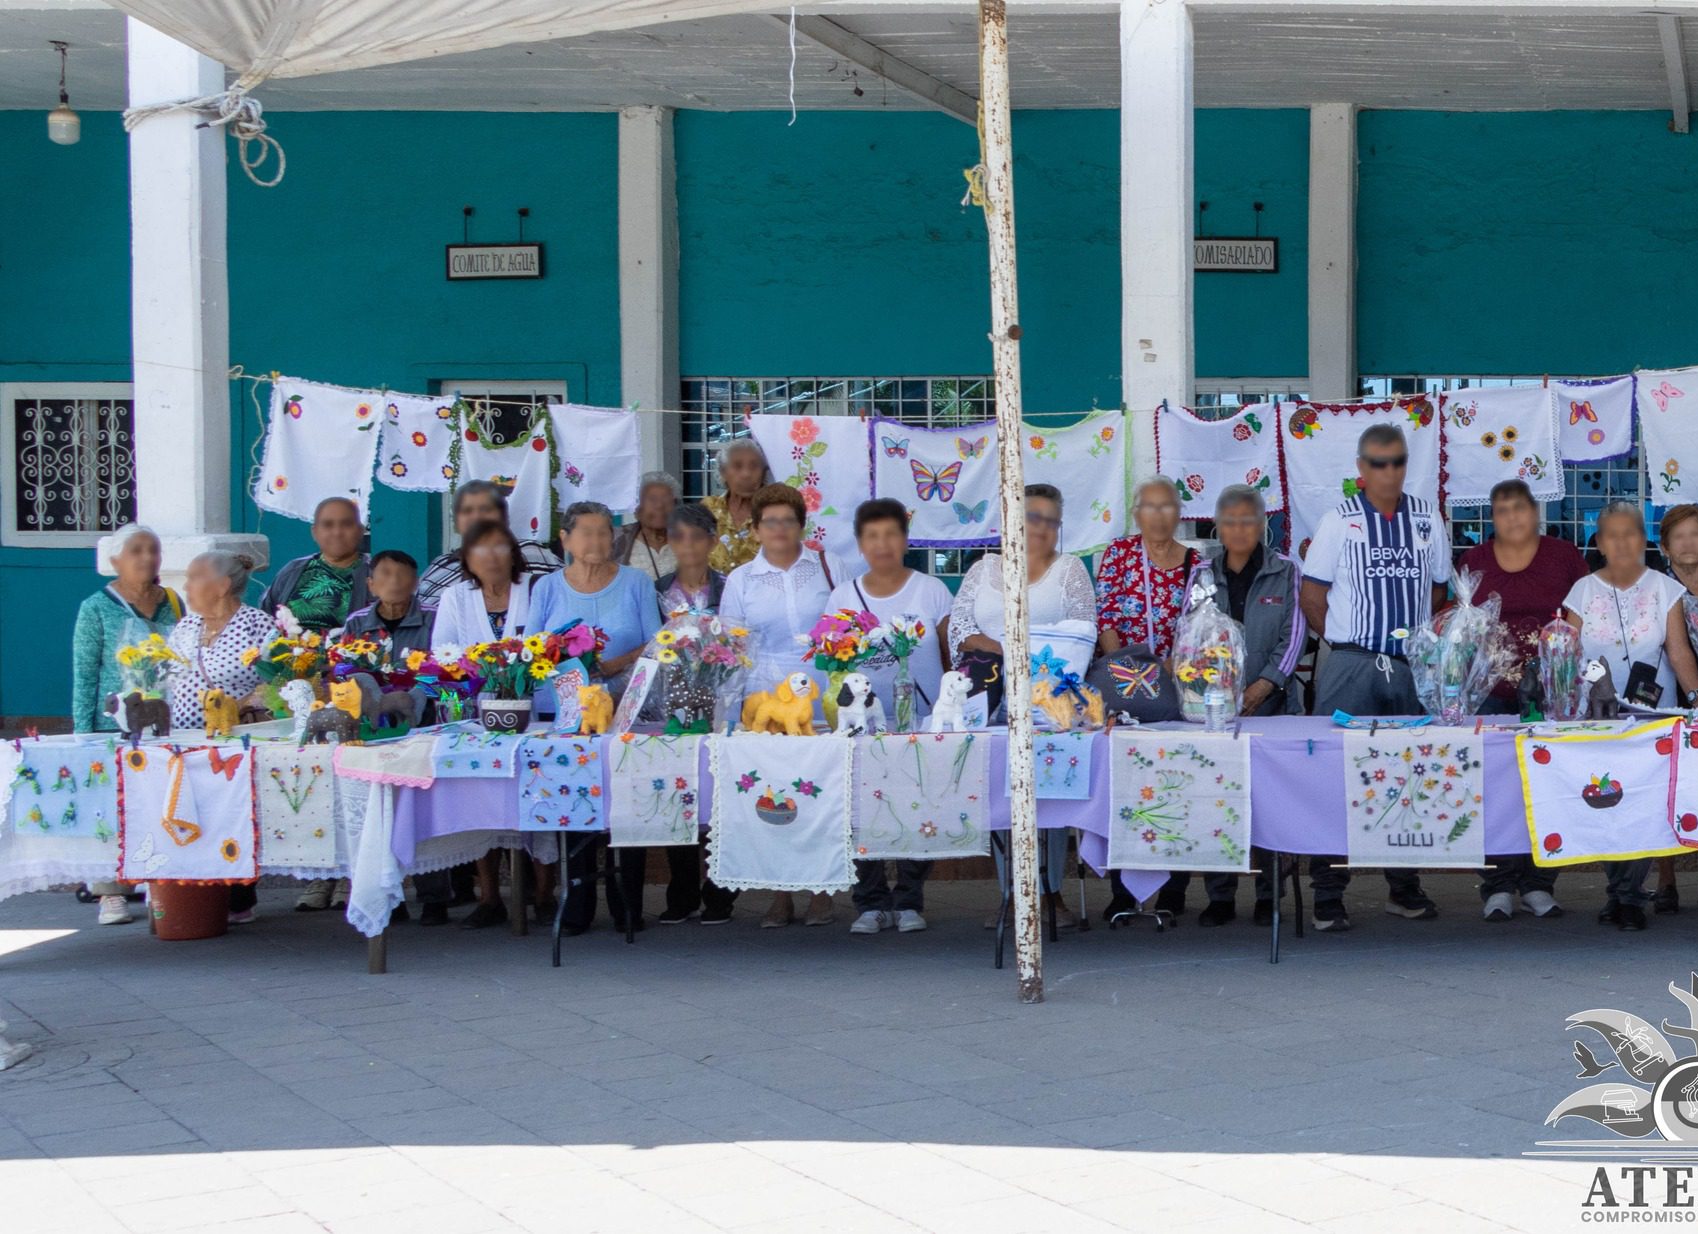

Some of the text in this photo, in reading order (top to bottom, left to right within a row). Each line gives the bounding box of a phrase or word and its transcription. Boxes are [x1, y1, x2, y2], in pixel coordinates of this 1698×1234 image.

[452, 251, 536, 273] COMITE DE AGUA
[1194, 244, 1273, 266] OMISARIADO
[1370, 547, 1413, 561] BBVA
[1387, 831, 1434, 847] LULU
